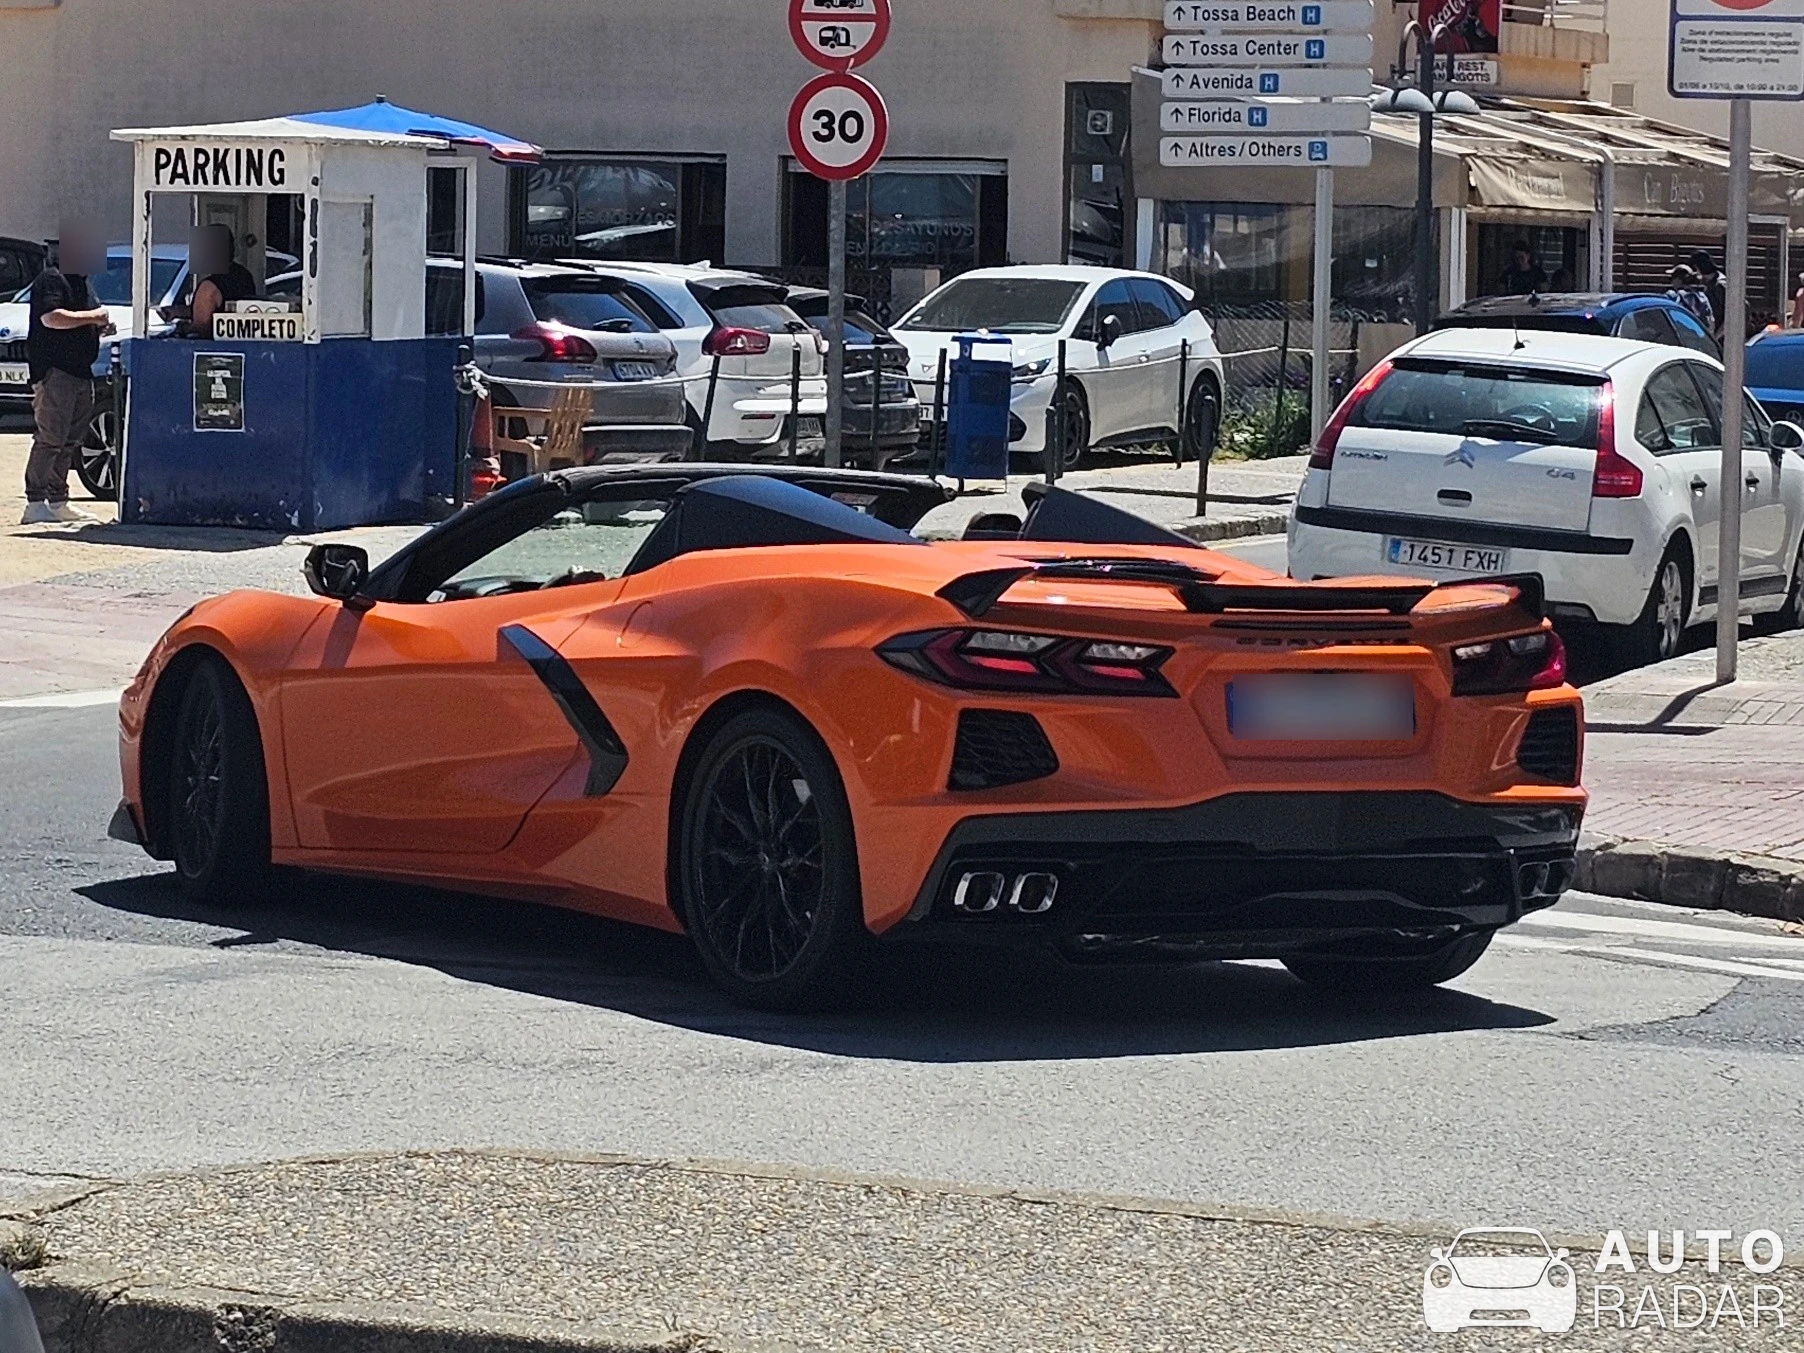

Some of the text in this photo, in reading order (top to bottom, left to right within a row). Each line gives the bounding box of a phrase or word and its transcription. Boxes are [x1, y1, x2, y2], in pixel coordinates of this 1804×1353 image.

[1191, 5, 1239, 21] Tossa
[1246, 5, 1296, 21] Beach
[1190, 40, 1238, 56] Tossa
[1245, 39, 1299, 56] Center
[1189, 73, 1254, 90] Avenida
[1188, 107, 1242, 123] Florida
[812, 109, 864, 143] 30
[154, 147, 285, 187] PARKING
[216, 318, 296, 339] COMPLETO
[5, 371, 25, 381] NLK
[1408, 543, 1500, 571] 1451 FXH
